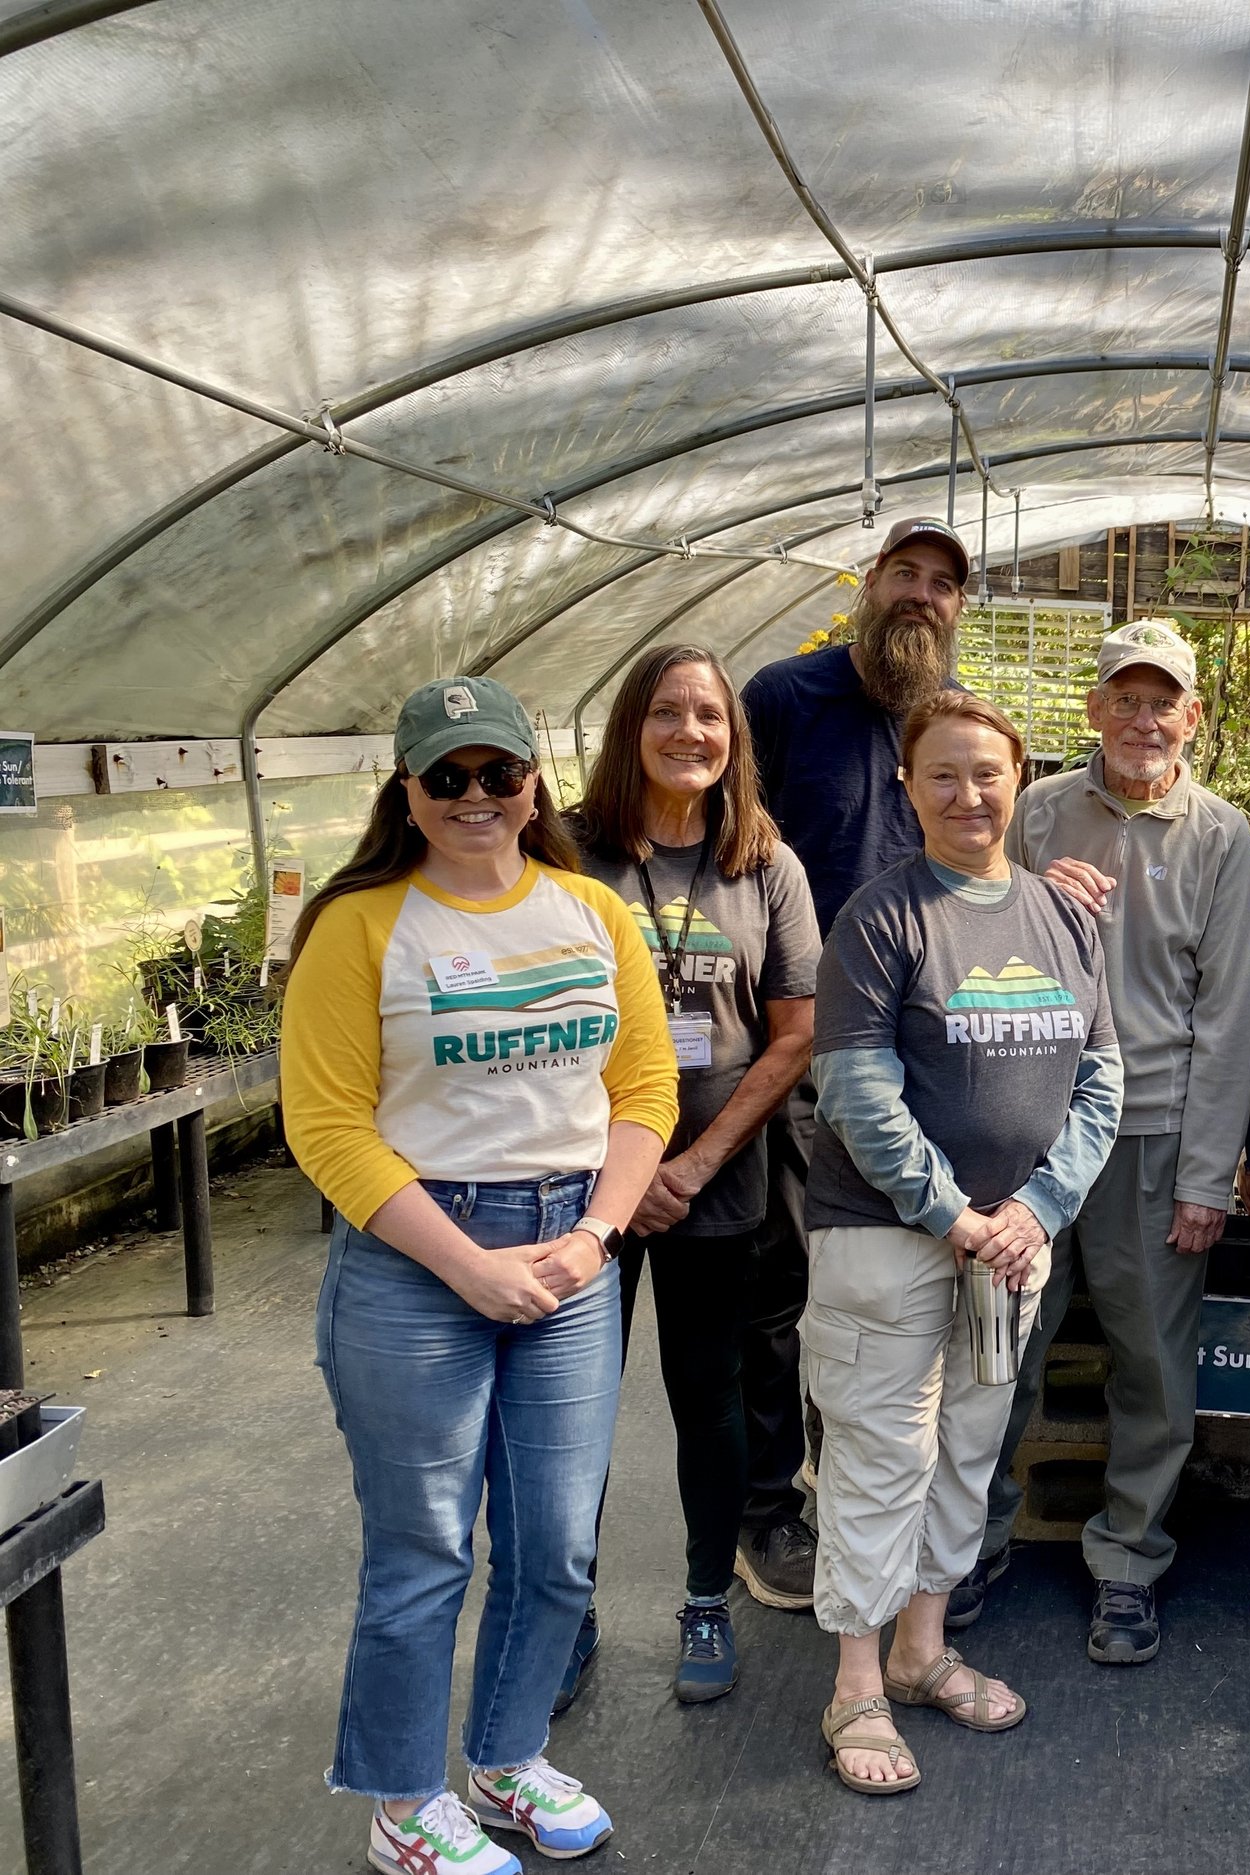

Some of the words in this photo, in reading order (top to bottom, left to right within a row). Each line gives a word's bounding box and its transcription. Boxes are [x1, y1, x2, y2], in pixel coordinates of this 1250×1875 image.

[2, 760, 23, 775] Sun/
[2, 773, 33, 786] Tolerant
[445, 981, 466, 989] Lauren
[945, 1010, 1086, 1044] RUFFNER
[433, 1013, 618, 1067] RUFFNER
[986, 1045, 1058, 1058] MOUNTAIN
[487, 1056, 581, 1076] MOUNTAIN
